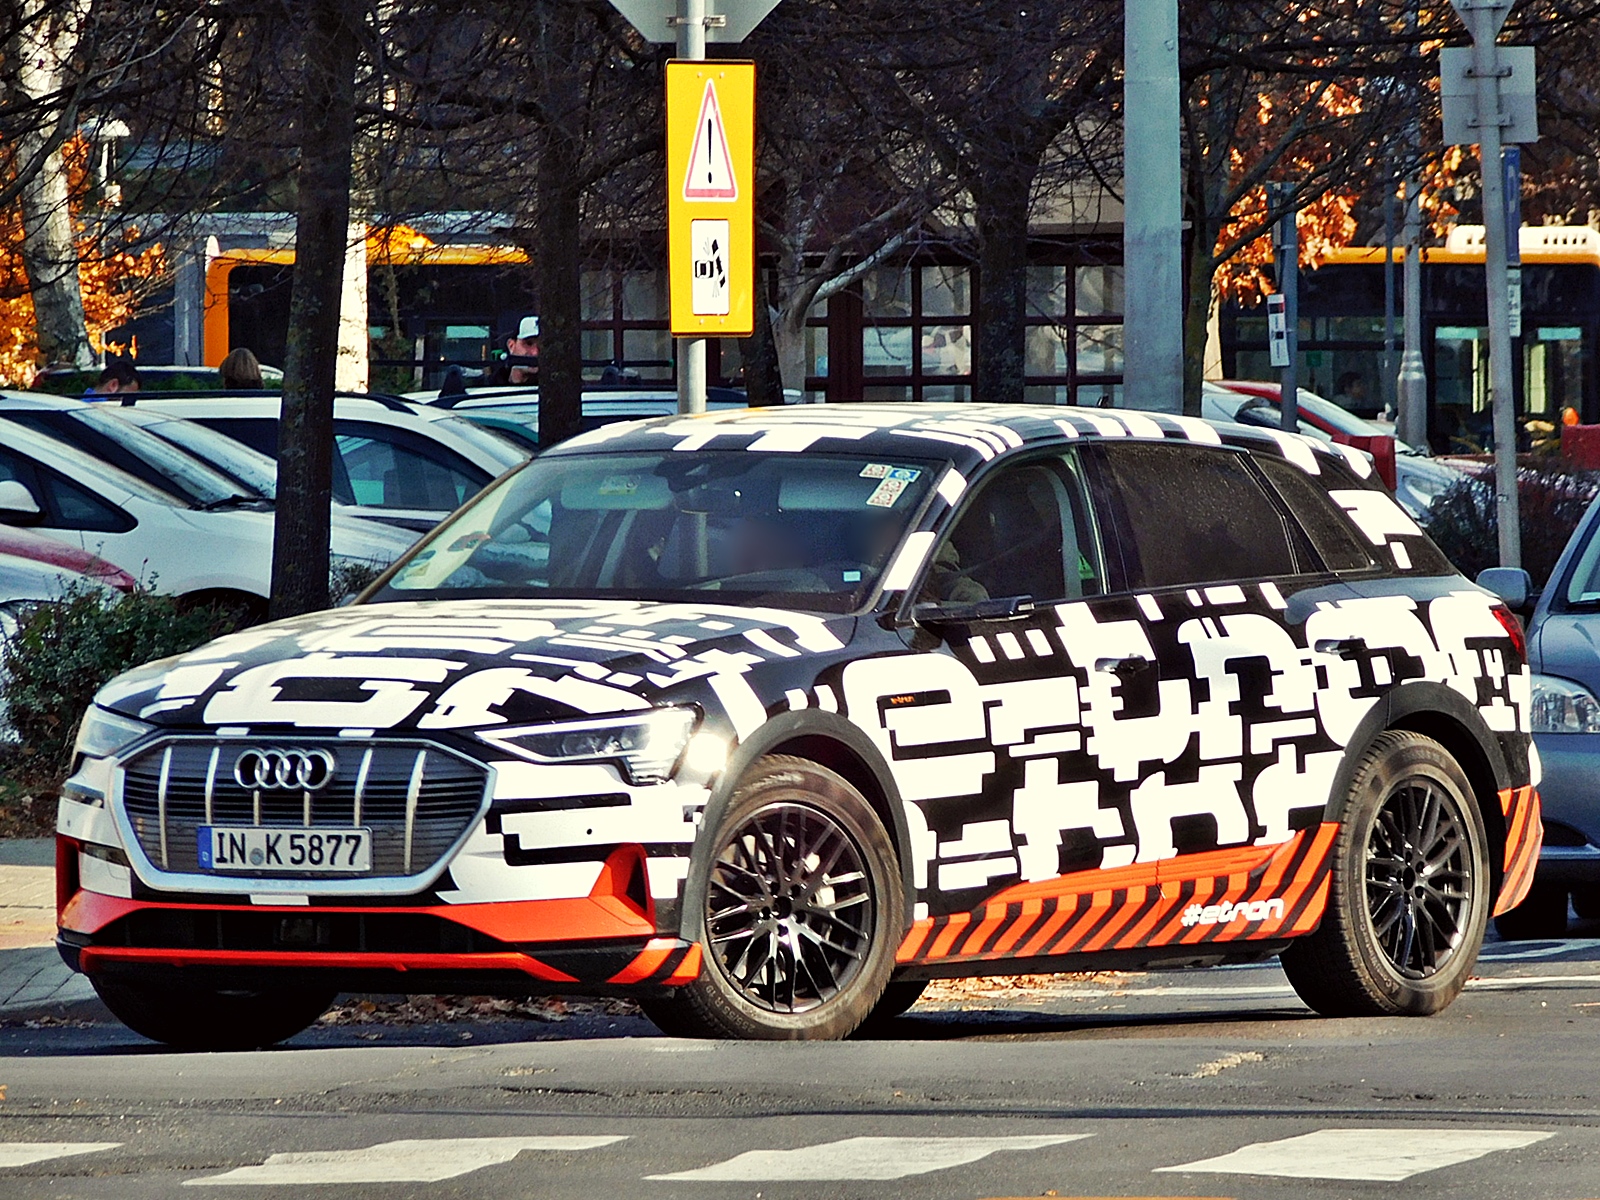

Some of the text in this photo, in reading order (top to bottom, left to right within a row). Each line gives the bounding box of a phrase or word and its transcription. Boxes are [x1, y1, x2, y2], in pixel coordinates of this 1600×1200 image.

[215, 832, 363, 866] IN K 5877
[723, 1006, 755, 1032] 255/55
